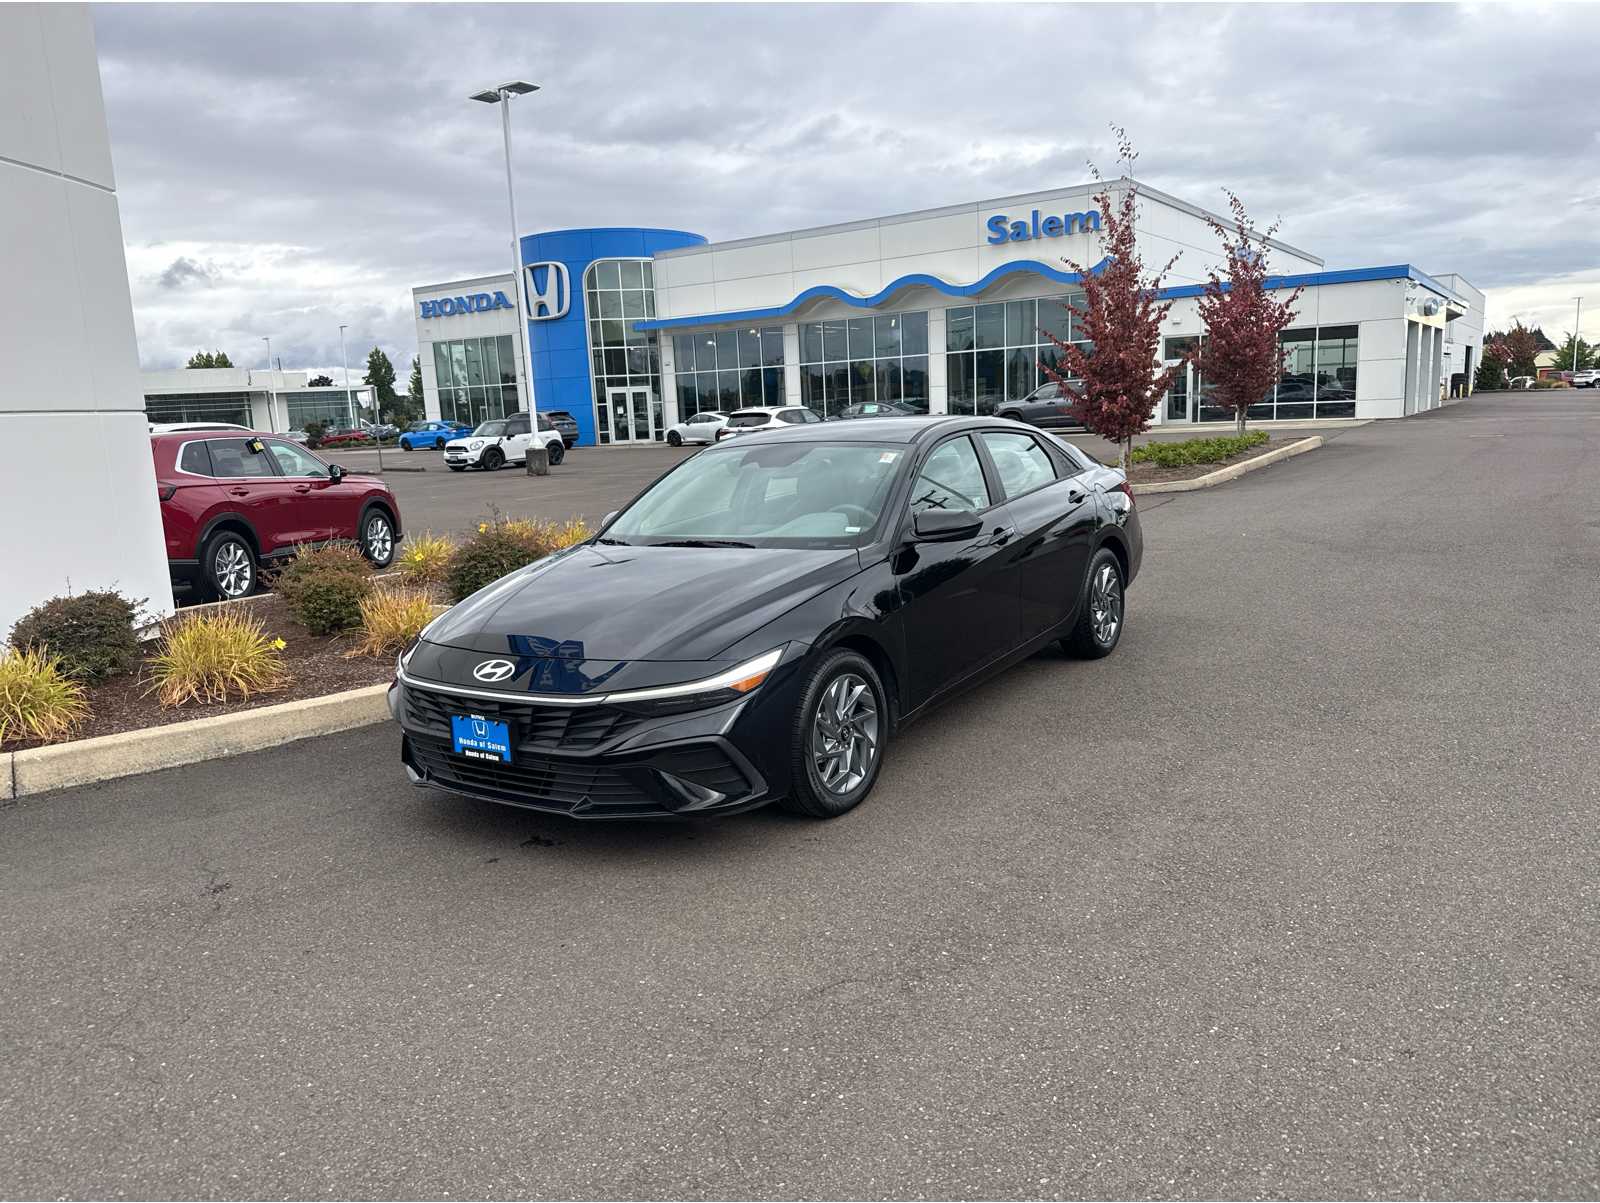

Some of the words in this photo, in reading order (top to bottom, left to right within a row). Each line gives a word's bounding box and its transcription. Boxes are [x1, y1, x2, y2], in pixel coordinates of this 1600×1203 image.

[986, 208, 1101, 245] Salem
[419, 291, 514, 319] HONDA
[458, 737, 478, 746] Honda
[487, 742, 506, 751] Salem
[465, 749, 479, 758] Honda
[485, 753, 500, 761] Salem
